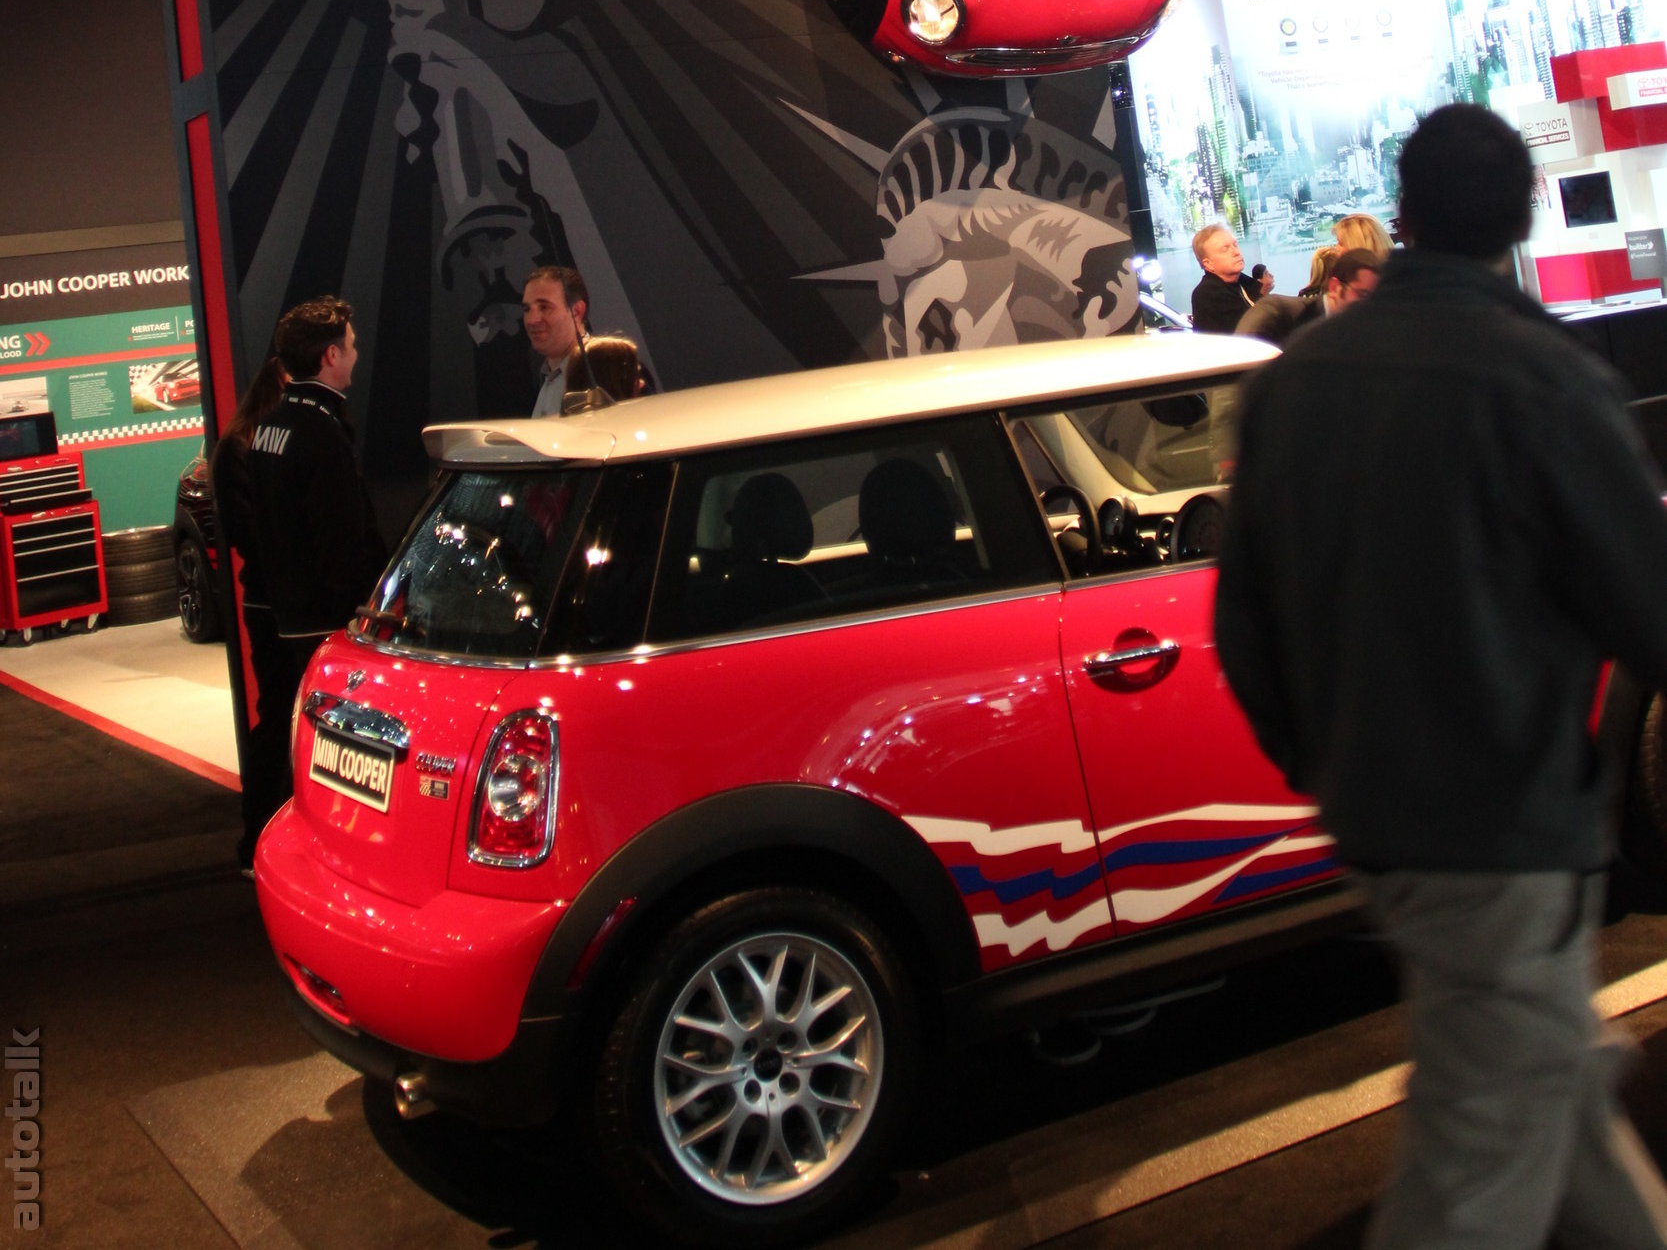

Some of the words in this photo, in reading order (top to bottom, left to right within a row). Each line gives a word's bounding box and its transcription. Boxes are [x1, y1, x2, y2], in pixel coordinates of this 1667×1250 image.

[1535, 117, 1568, 132] TOYOTA
[0, 279, 53, 300] JOHN
[57, 271, 131, 294] COOPER
[131, 322, 171, 334] HERITAGE
[314, 737, 339, 772] MINI
[339, 748, 387, 793] COOPER
